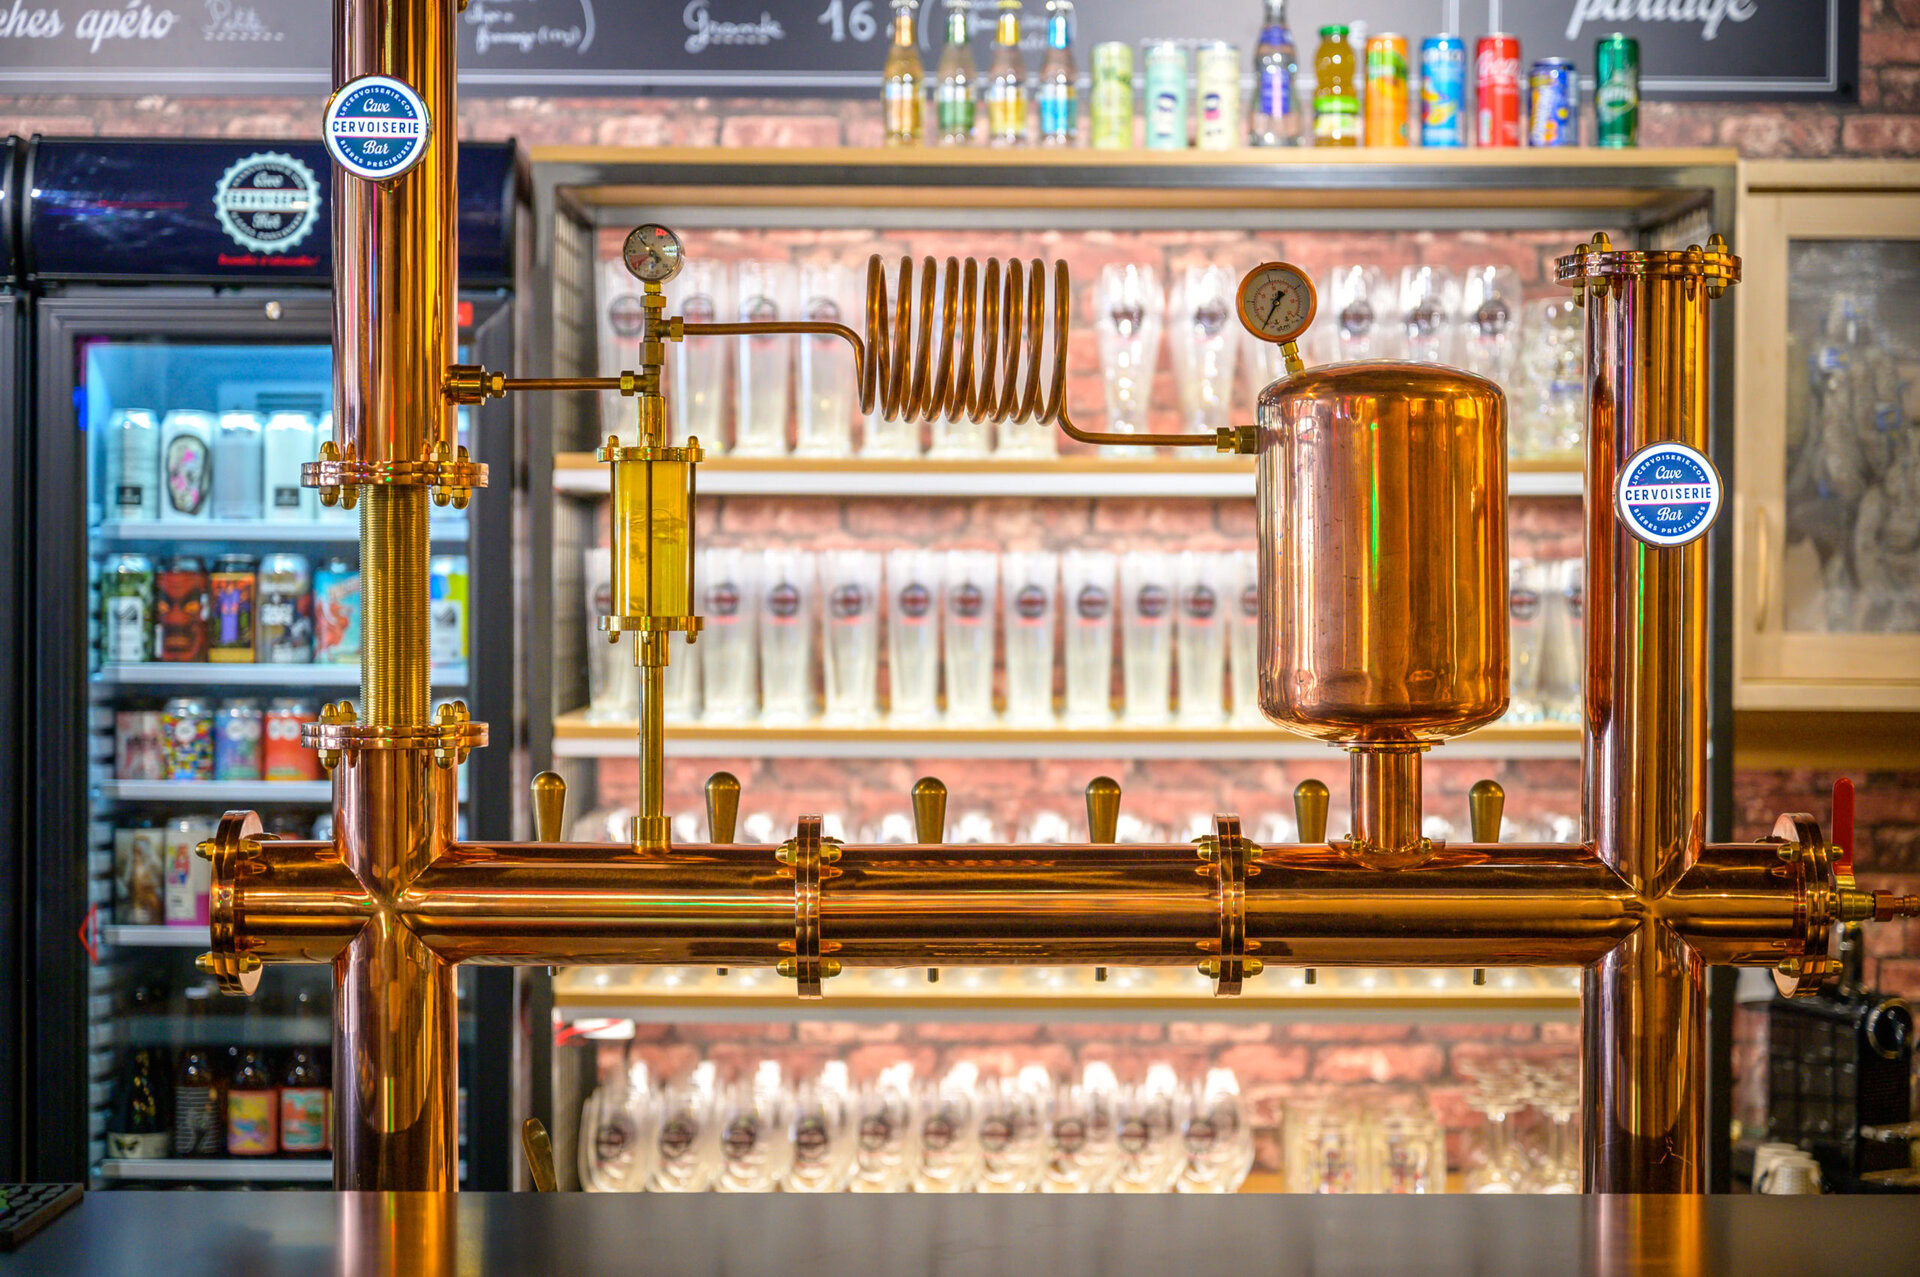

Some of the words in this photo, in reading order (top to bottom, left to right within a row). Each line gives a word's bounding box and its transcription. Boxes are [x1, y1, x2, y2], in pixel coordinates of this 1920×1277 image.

[75, 0, 180, 54] apéro
[363, 97, 391, 112] Cave
[332, 121, 419, 134] CERVOISERIE
[362, 139, 390, 154] Bar
[1655, 465, 1683, 480] Cave
[1625, 487, 1712, 501] CERVOISERIE
[1633, 508, 1658, 531] BIÈRES
[1656, 506, 1684, 522] Bar
